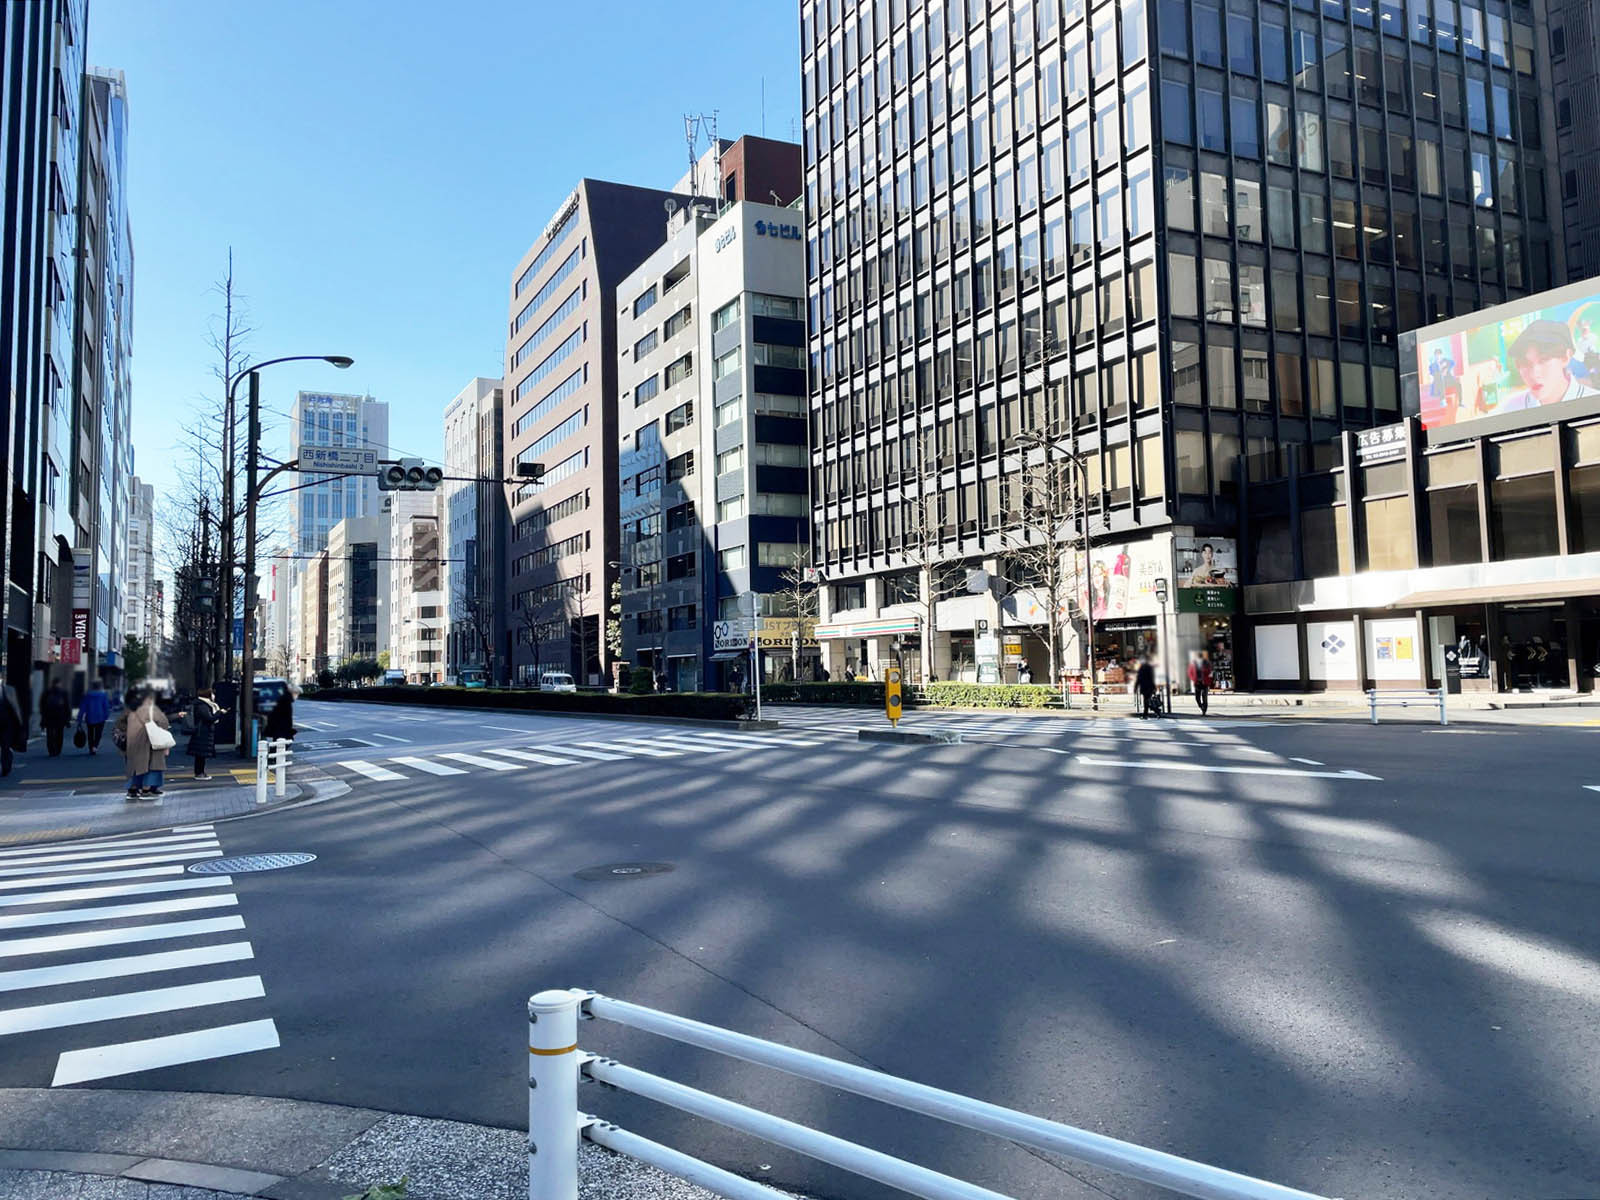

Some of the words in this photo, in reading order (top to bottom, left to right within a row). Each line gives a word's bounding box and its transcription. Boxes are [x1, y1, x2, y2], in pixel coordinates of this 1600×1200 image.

[303, 449, 374, 463] 西新橋二丁目
